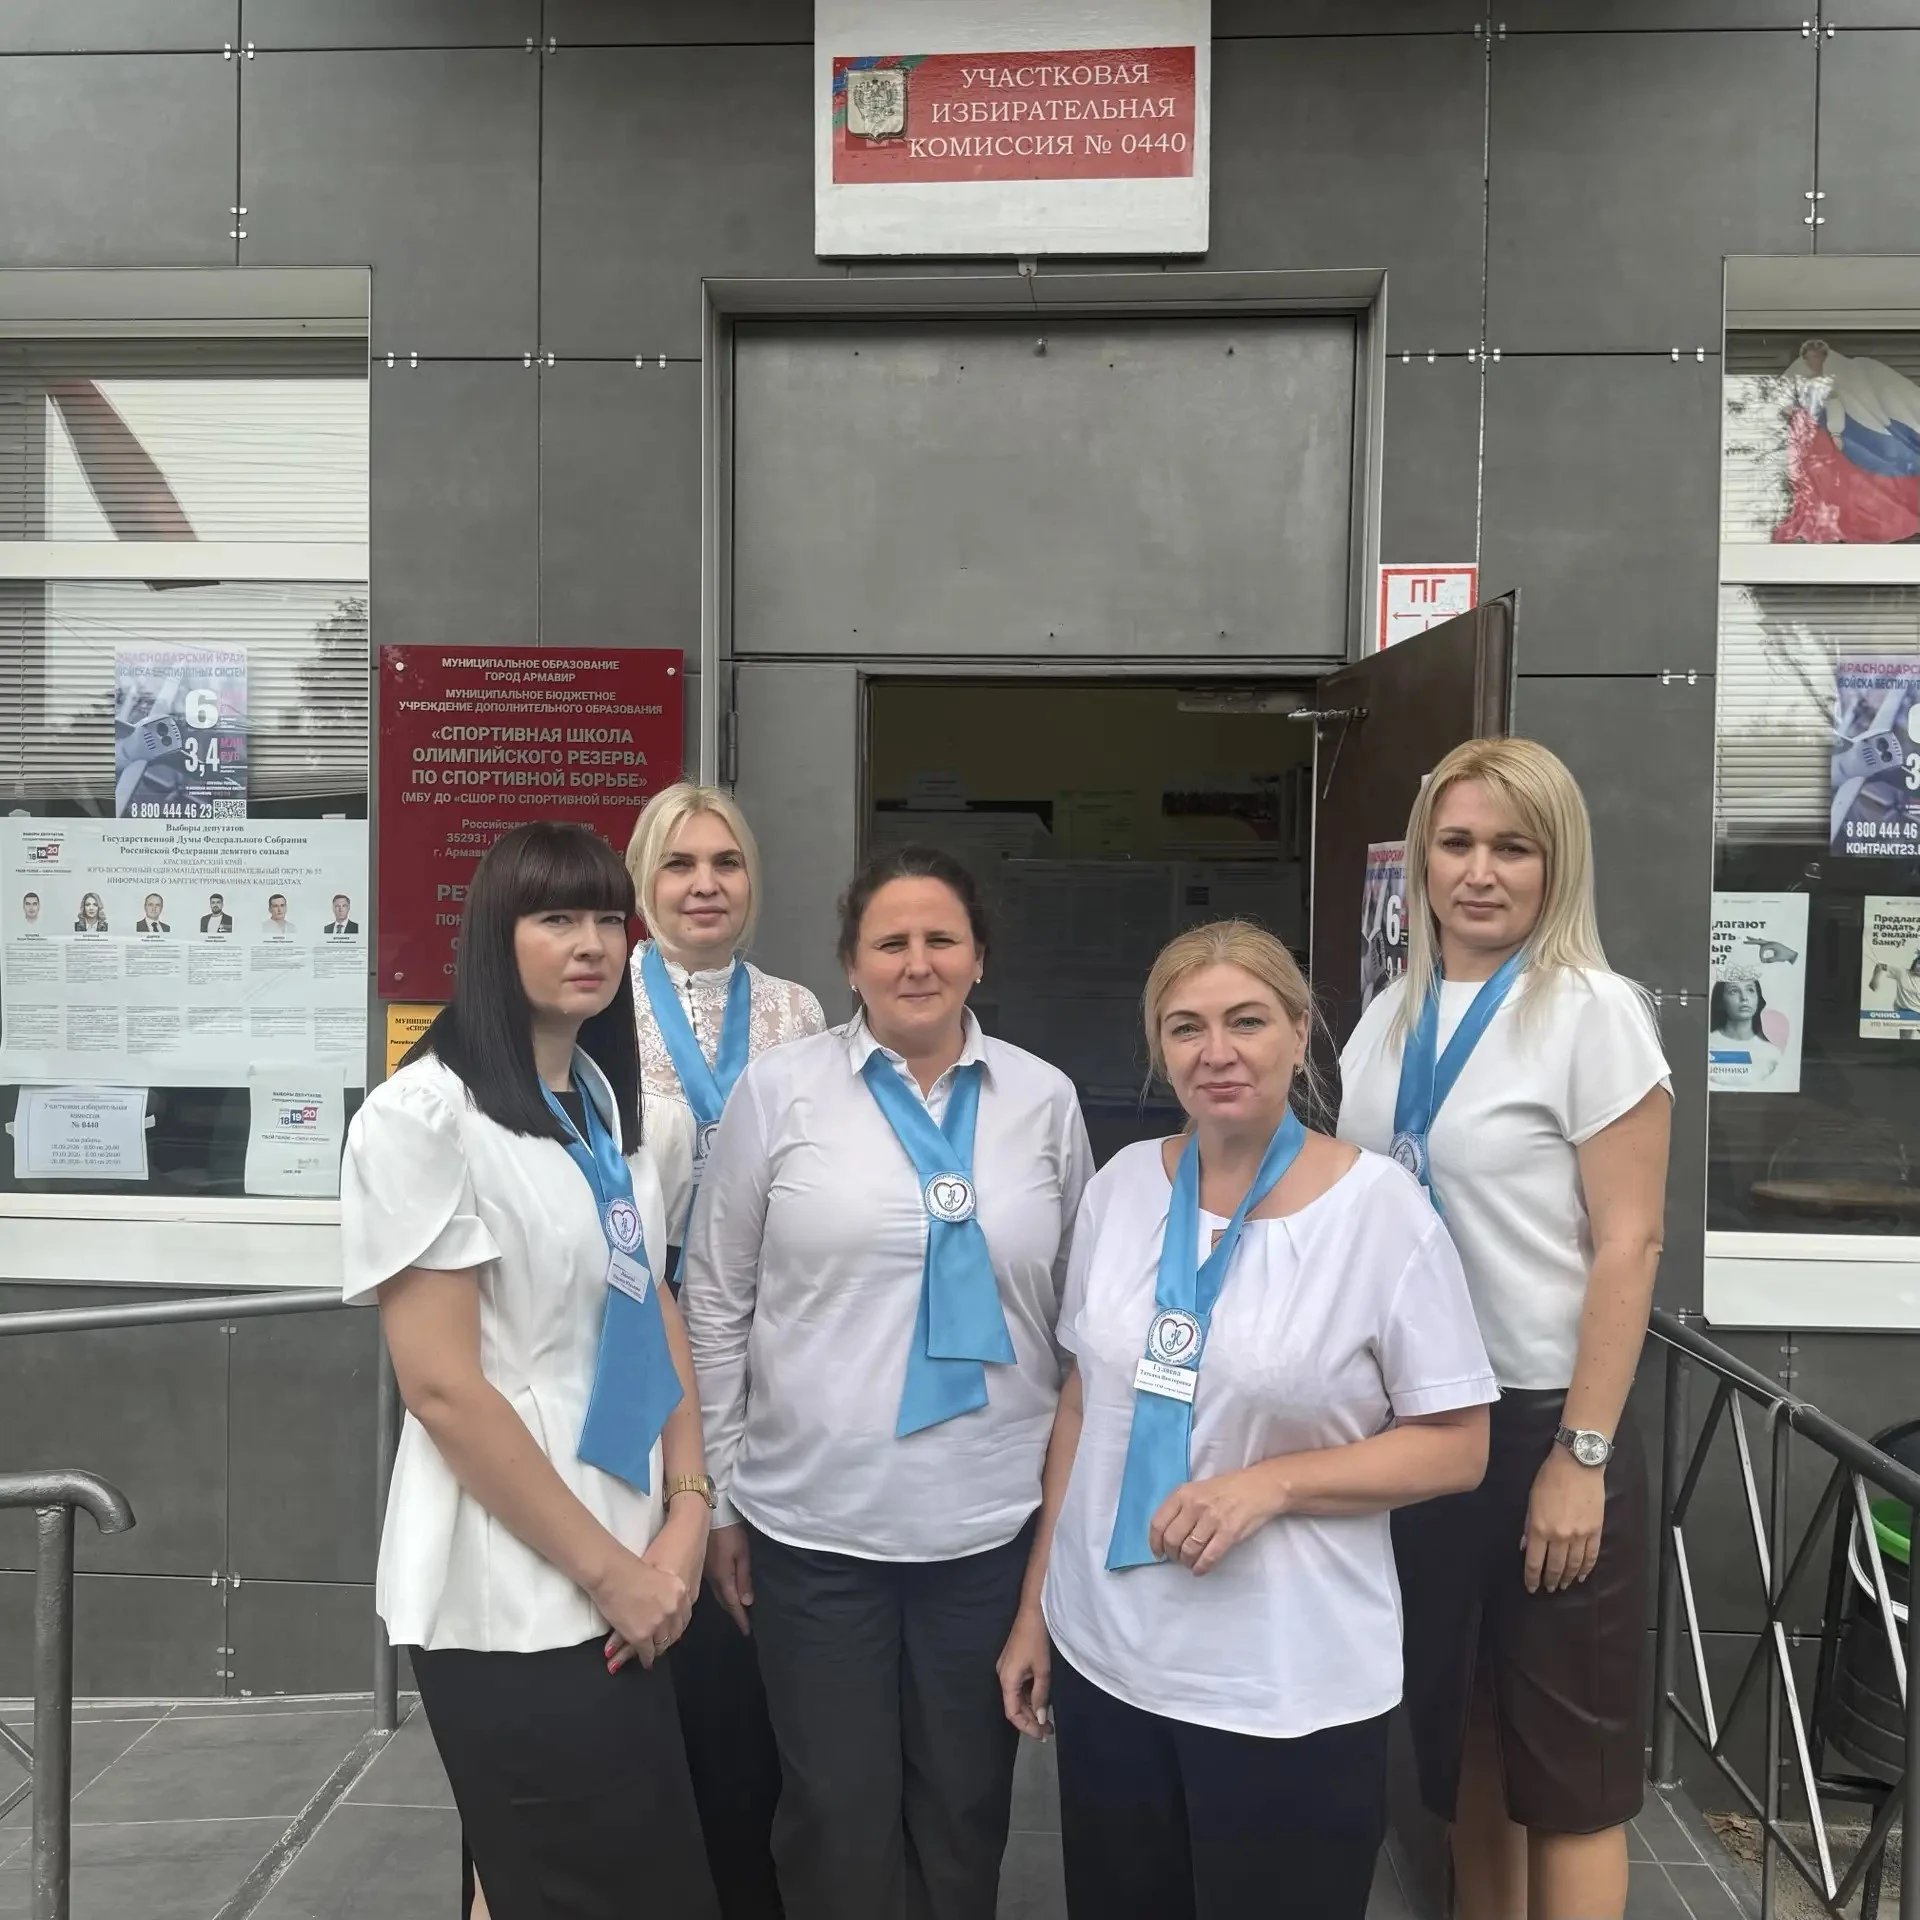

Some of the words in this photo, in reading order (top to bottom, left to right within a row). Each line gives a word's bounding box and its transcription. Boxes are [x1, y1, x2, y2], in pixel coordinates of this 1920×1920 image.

[961, 64, 1149, 88] УЧАСТКОВАЯ
[932, 98, 1175, 124] ИЗБИРАТЕЛЬНАЯ
[909, 136, 1073, 158] КОМИССИЯ
[1085, 135, 1112, 154] №
[1121, 132, 1185, 154] 0440
[1411, 579, 1446, 602] ПГ
[442, 658, 540, 669] МУНИЦИПАЛЬНОЕ
[542, 660, 619, 670] ОБРАЗОВАНИЕ
[485, 672, 520, 683] ГОРОД
[523, 673, 575, 682] АРМАВИР
[446, 689, 543, 700] МУНИЦИПАЛЬНОЕ
[546, 691, 616, 701] БЮДЖЕТНОЕ
[186, 689, 218, 729] 6
[400, 701, 473, 712] УЧРЕЖДЕНИЕ
[475, 703, 582, 714] ДОПОЛНИТЕЛЬНОГО
[586, 704, 662, 715] ОБРАЗОВАНИЯ
[432, 726, 562, 743] «СПОРТИВНАЯ
[567, 729, 633, 743] ШКОЛА
[185, 737, 220, 776] 3,4
[413, 746, 562, 764] ОЛИМПИЙСКОГО
[568, 752, 648, 766] РЕЗЕРВА
[412, 770, 437, 784] ПО
[442, 769, 564, 786] СПОРТИВНОЙ
[571, 773, 647, 788] БОРЬБЕ»
[401, 792, 431, 804] (МБУ
[434, 793, 451, 805] ДО
[455, 793, 495, 804] «СШОР
[499, 794, 515, 804] ПО
[519, 792, 599, 805] СПОРТИВНОЙ
[132, 804, 138, 817] 8
[141, 803, 159, 818] 800
[163, 803, 181, 818] 444
[185, 804, 196, 818] 46
[200, 804, 211, 818] 23
[166, 824, 201, 834] Выборы
[202, 825, 244, 834] депутатов
[1847, 821, 1853, 837] 8
[1856, 822, 1876, 837] 800
[1880, 822, 1900, 838] 444
[1904, 823, 1917, 838] 46
[102, 835, 174, 844] Государственной
[176, 836, 201, 845] Думы
[204, 836, 263, 845] Федерального
[265, 836, 308, 846] Собрания
[447, 833, 491, 845] 352931,
[120, 846, 170, 855] Российской
[171, 847, 219, 856] Федерации
[434, 849, 443, 858] г.
[1846, 843, 1920, 855] КОНТРАКТ23.
[1386, 895, 1401, 946] 6
[1712, 920, 1766, 931] лагают
[1874, 923, 1915, 931] продать
[1872, 939, 1906, 948] банку?
[304, 1110, 315, 1118] 20
[280, 1117, 289, 1125] 18
